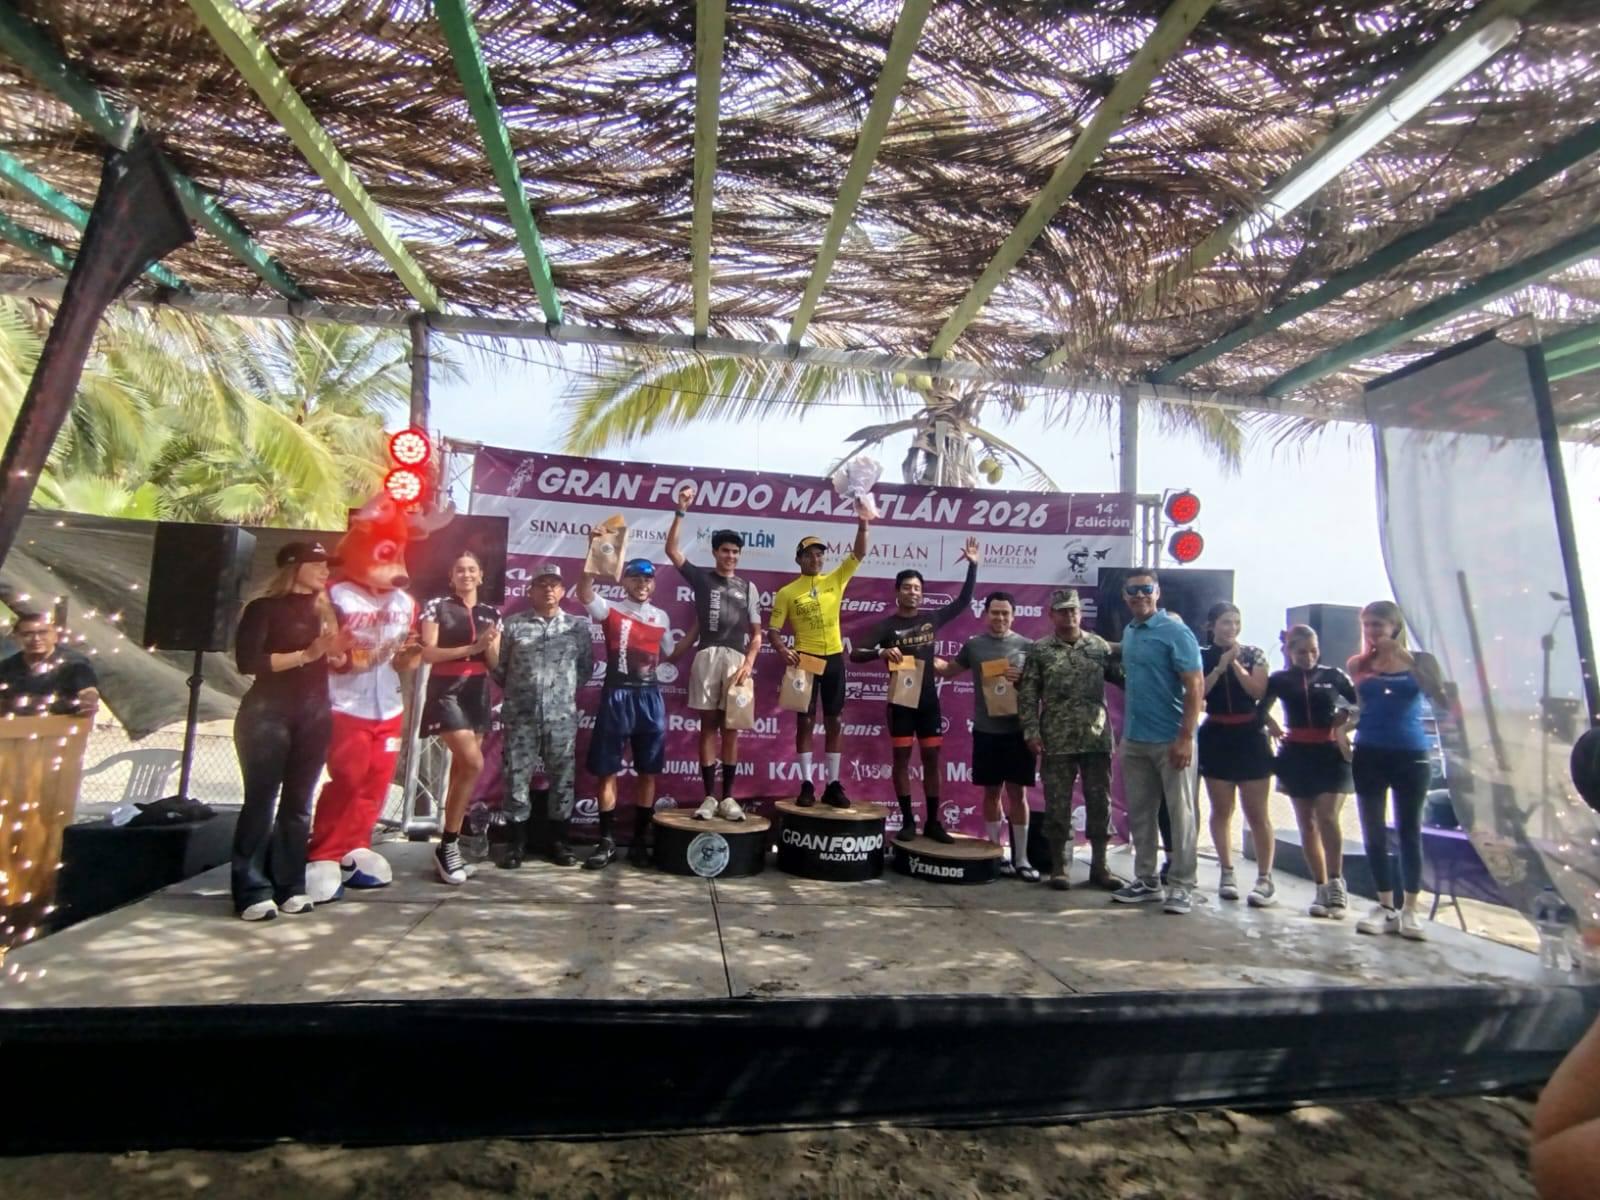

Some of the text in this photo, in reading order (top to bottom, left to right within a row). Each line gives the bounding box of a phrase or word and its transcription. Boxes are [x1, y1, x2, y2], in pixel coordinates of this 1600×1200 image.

[537, 467, 1049, 529] GRAN FONDO MAZTLÁN 2026
[529, 519, 592, 536] SINALO
[1074, 513, 1131, 529] Edición
[825, 541, 929, 560] MAATLÁN
[984, 543, 1037, 556] IMDEM
[662, 761, 699, 774] JUAN
[783, 829, 883, 853] GRAN FONDO
[908, 856, 964, 878] VENADOS
